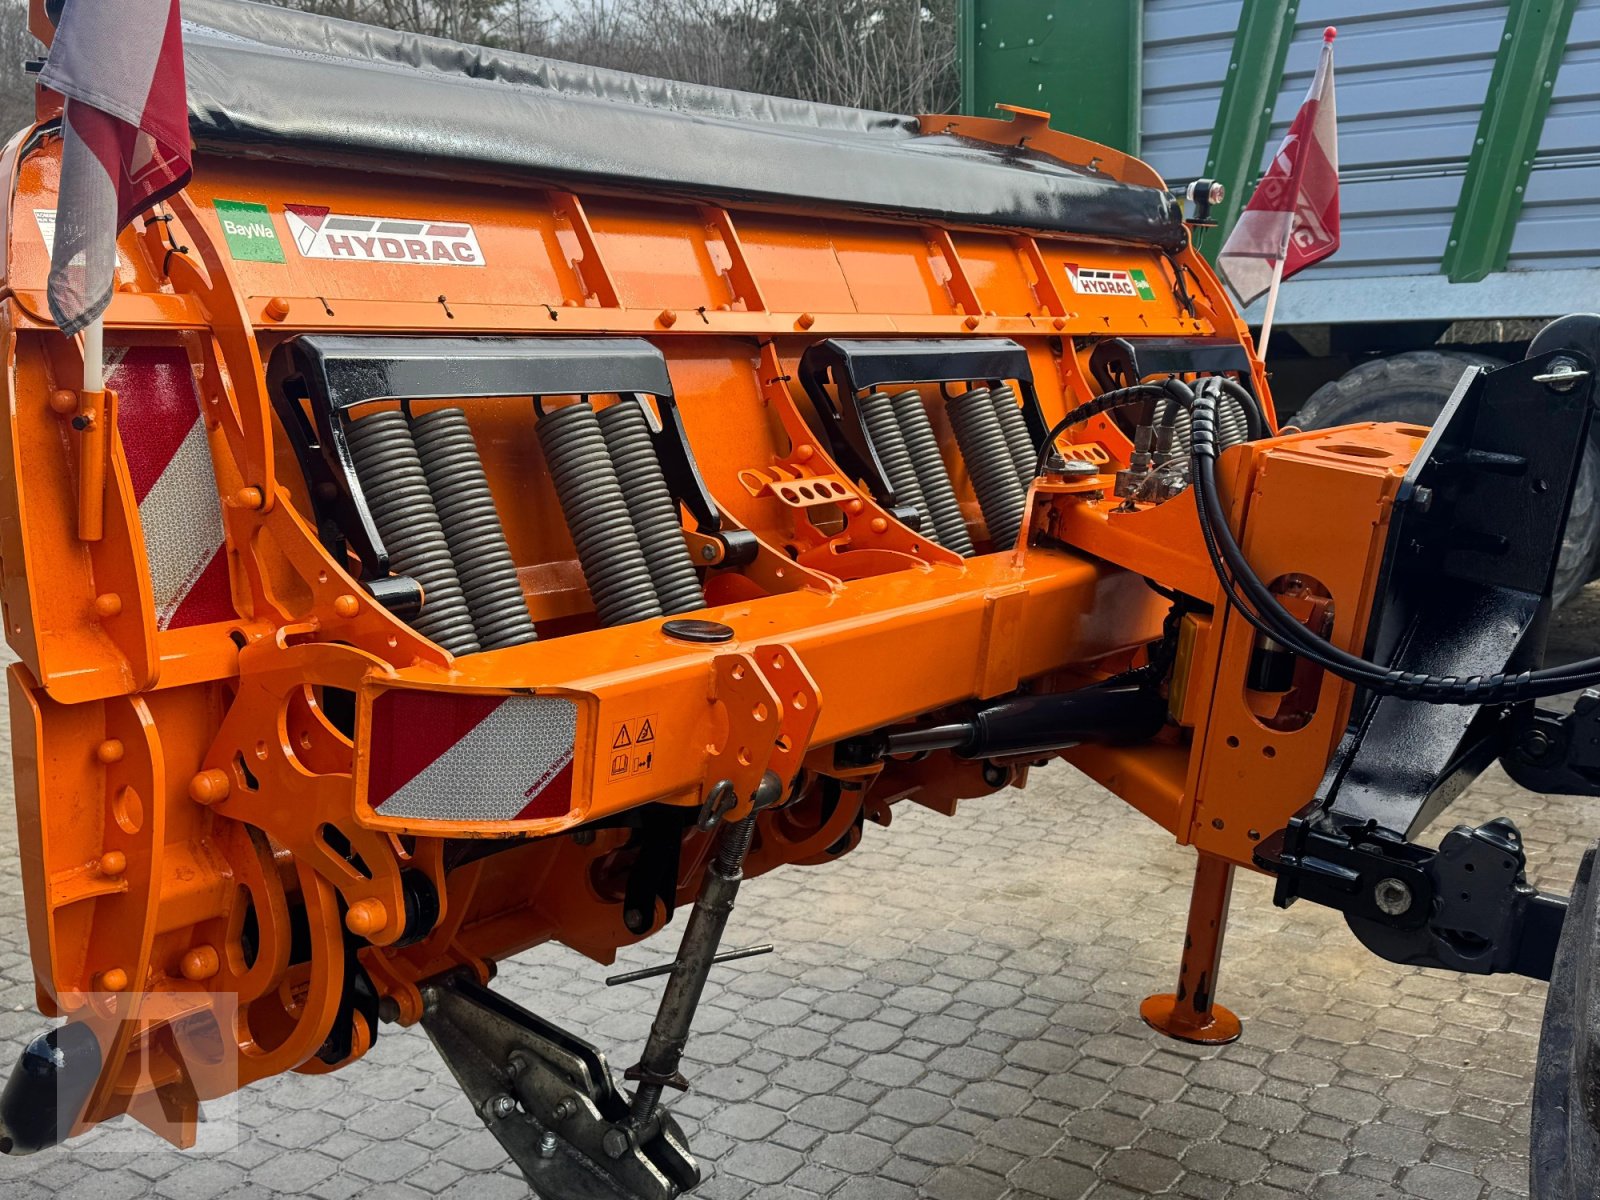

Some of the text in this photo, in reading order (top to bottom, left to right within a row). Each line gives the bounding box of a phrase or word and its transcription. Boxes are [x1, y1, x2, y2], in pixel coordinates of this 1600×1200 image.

[223, 220, 275, 239] BayWa
[325, 233, 477, 263] HYDRAC
[1080, 279, 1133, 295] HYDRAC
